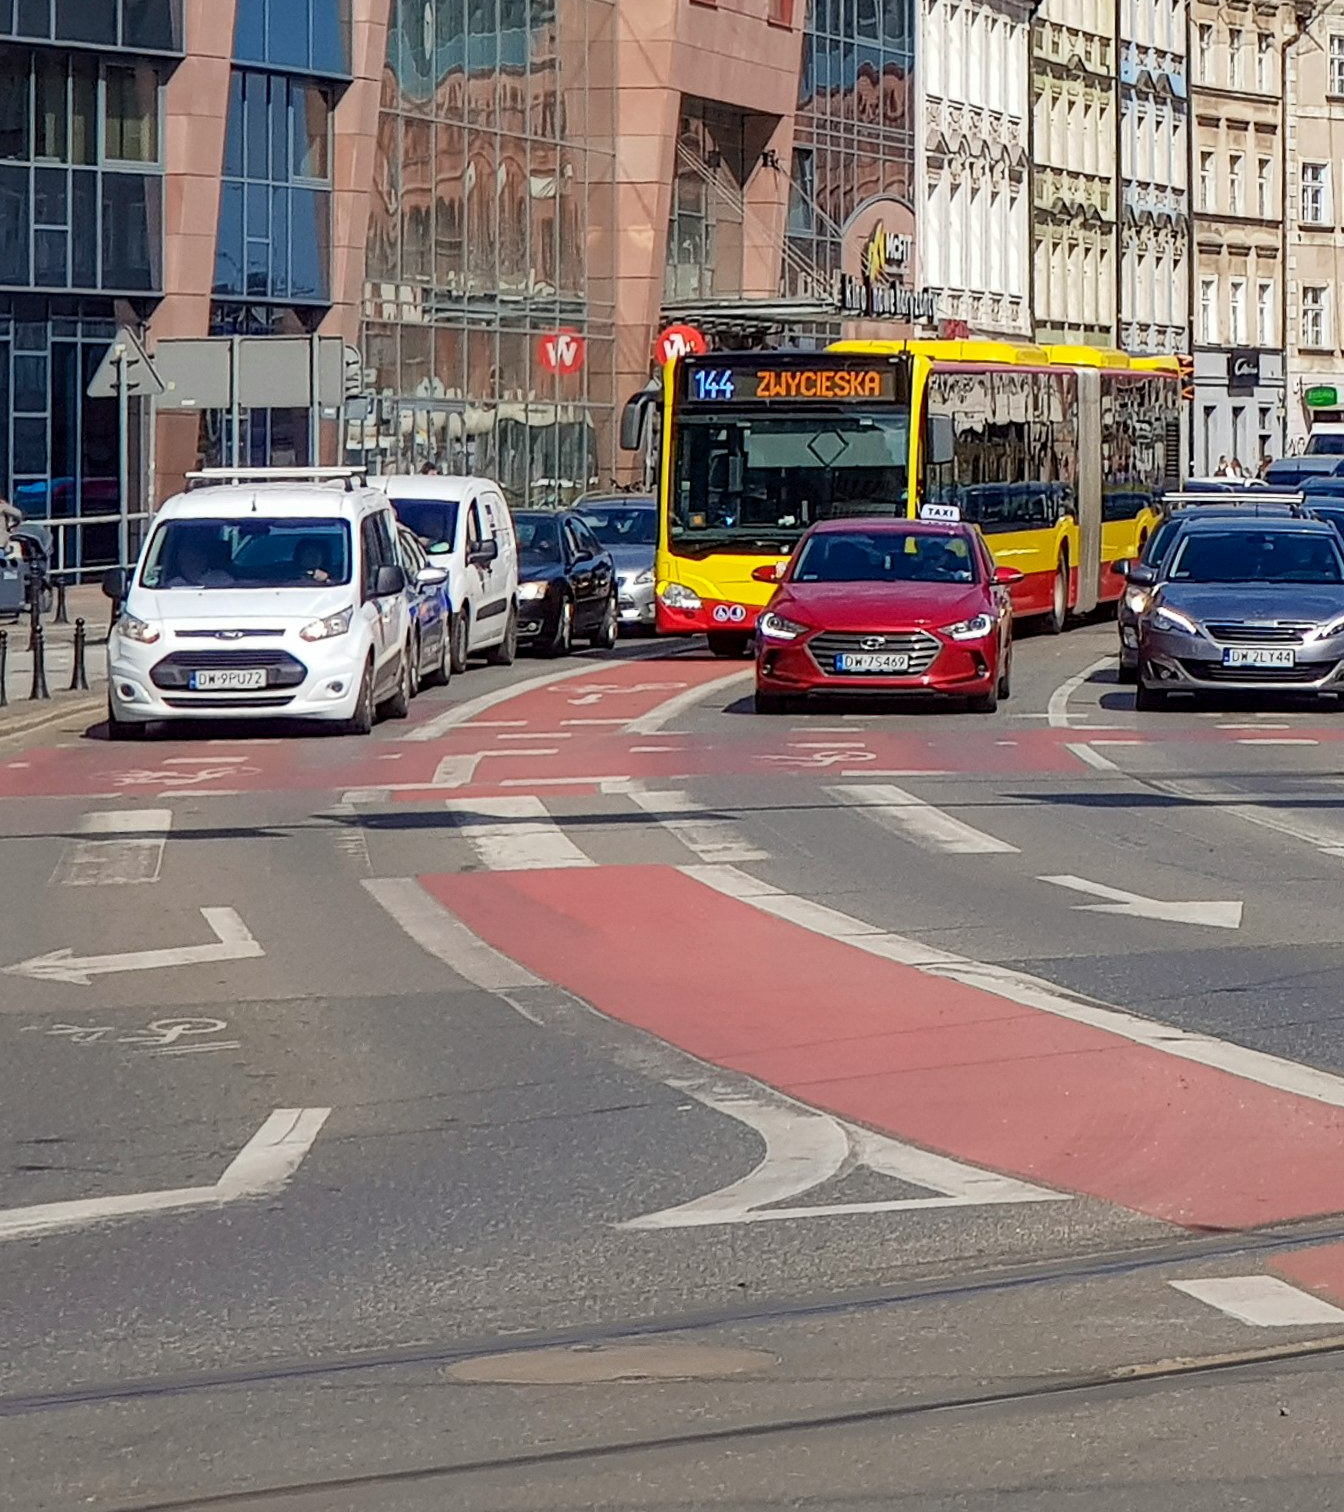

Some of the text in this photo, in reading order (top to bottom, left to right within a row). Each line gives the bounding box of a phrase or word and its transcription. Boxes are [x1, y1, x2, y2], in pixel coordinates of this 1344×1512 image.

[695, 369, 881, 399] 144 ZWYCIĘSKA
[928, 508, 953, 517] TAXI
[845, 656, 863, 668] DW
[199, 672, 262, 685] DW 9PU72
